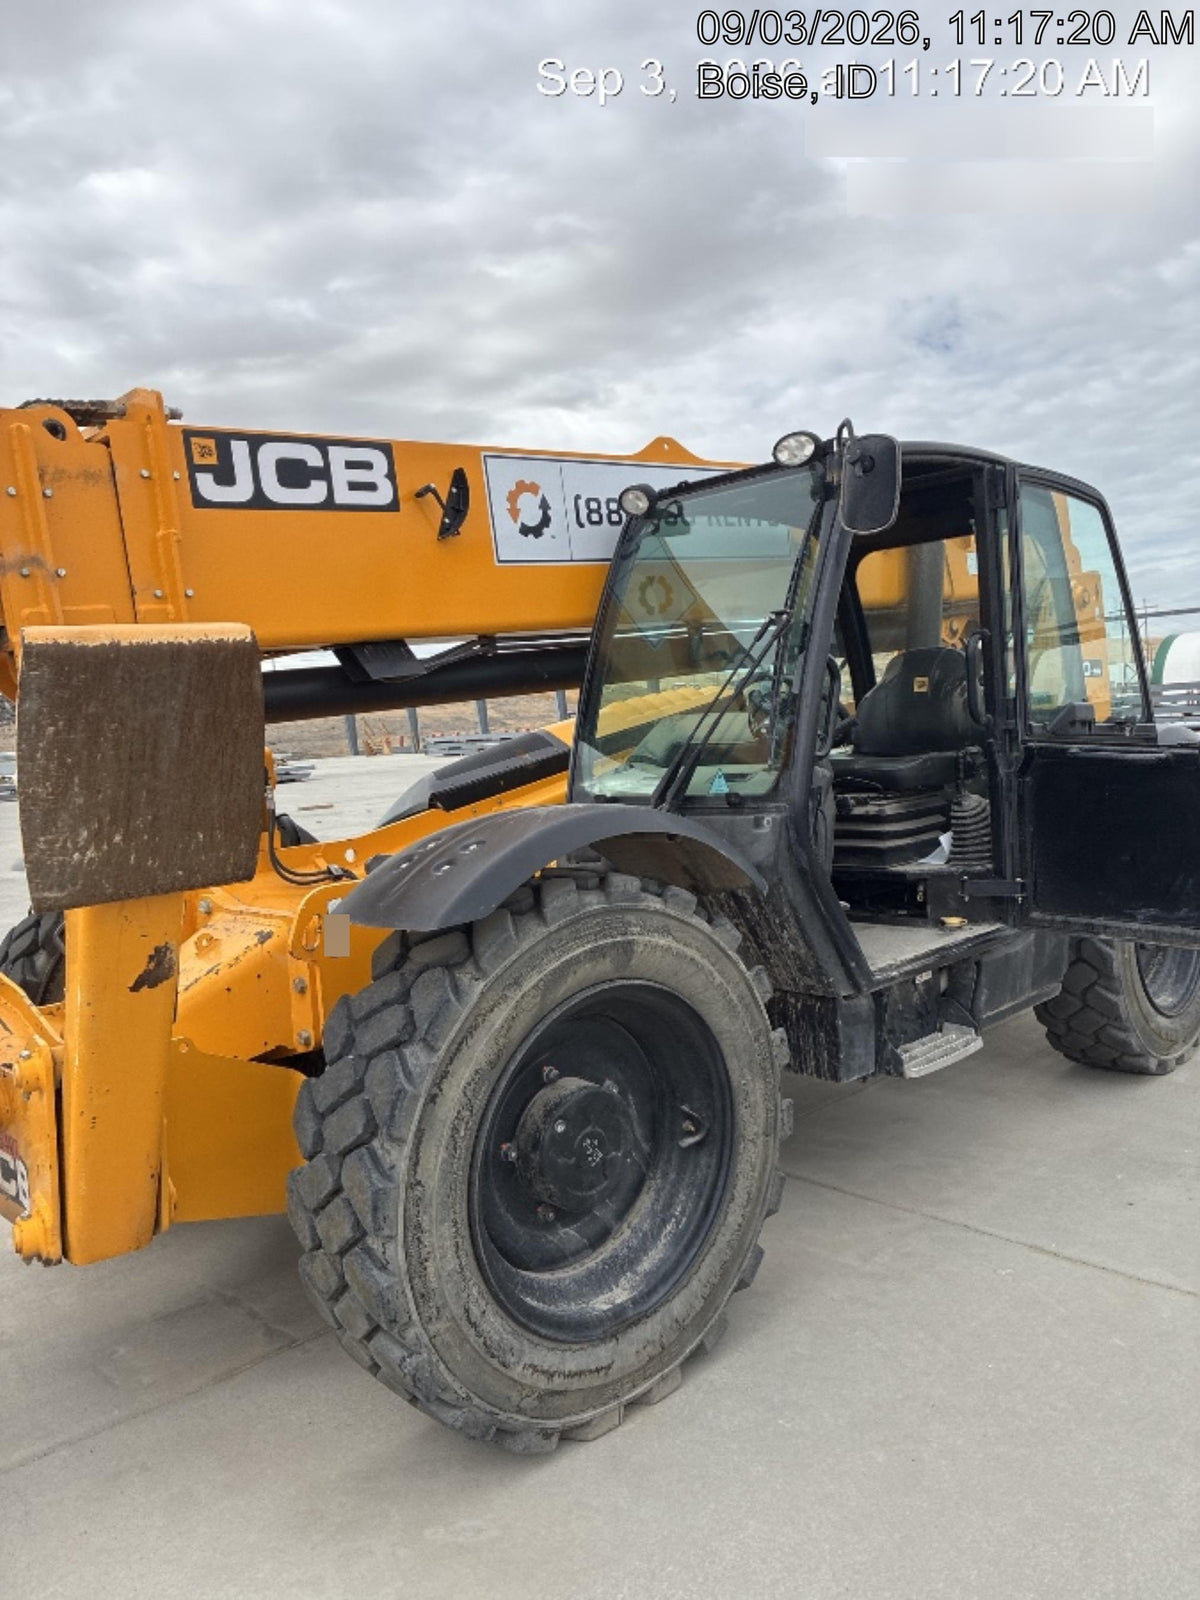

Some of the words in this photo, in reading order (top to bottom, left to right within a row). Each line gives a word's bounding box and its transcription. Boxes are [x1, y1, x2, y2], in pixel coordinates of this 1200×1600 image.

[194, 439, 394, 506] JCB
[574, 493, 624, 528] (88
[0, 1149, 30, 1212] CB
